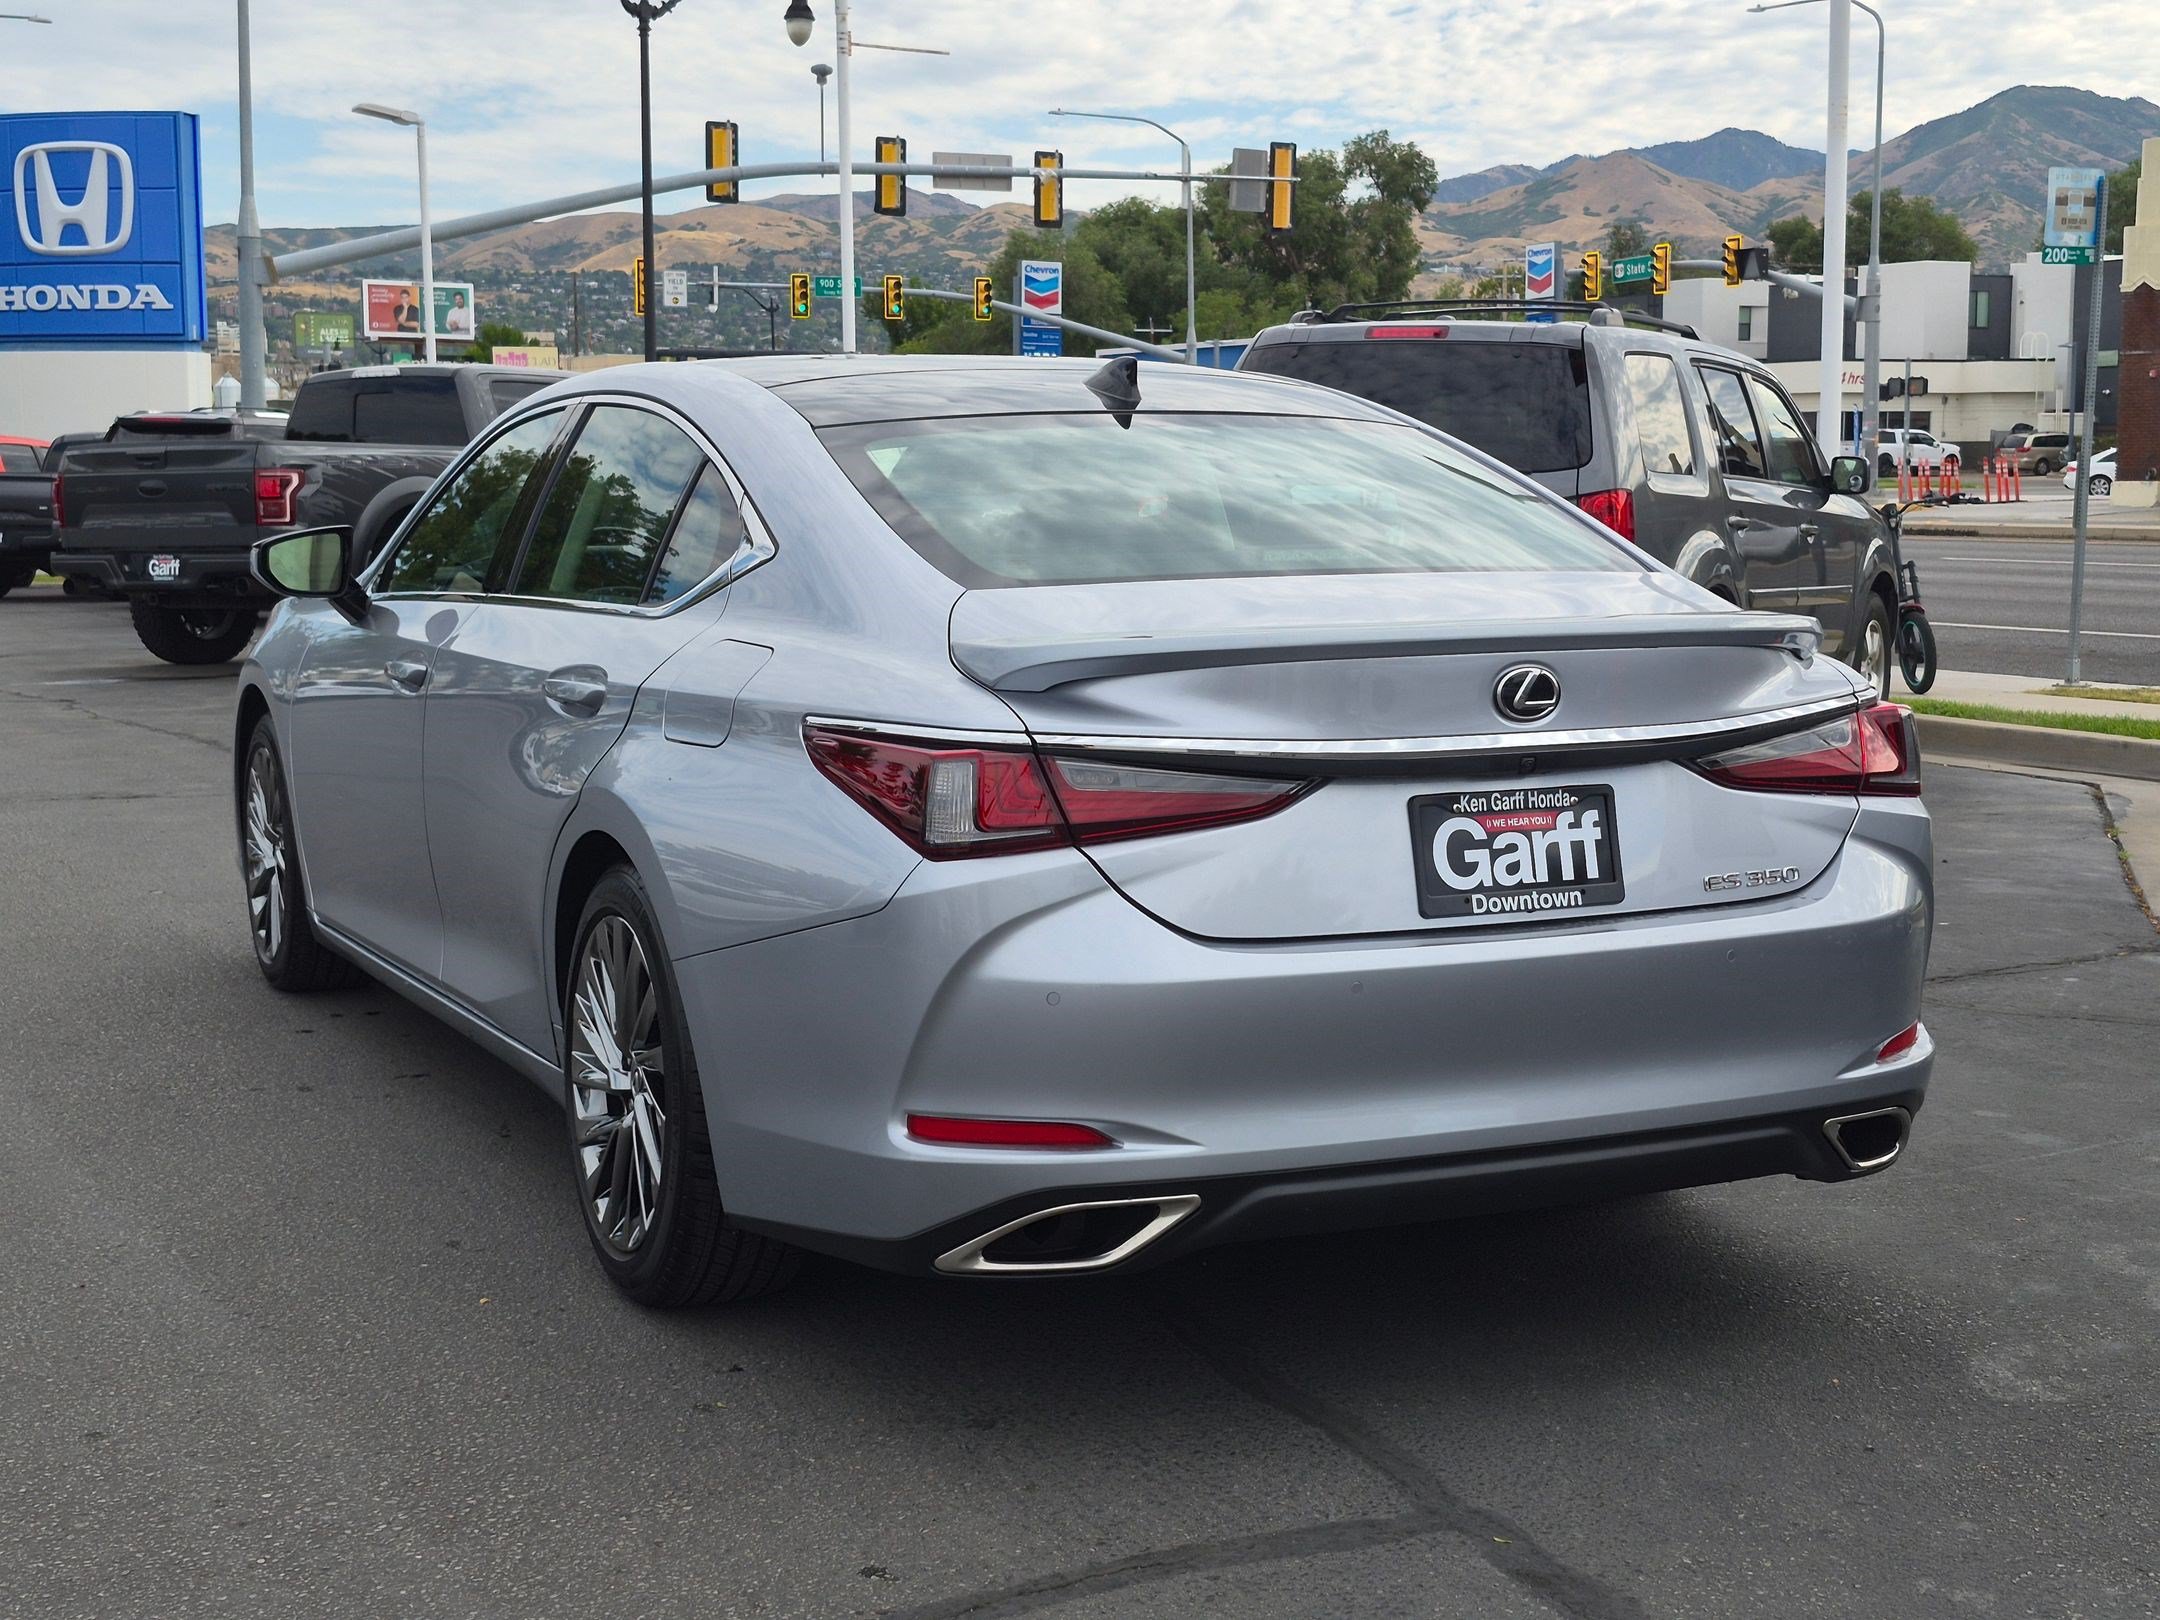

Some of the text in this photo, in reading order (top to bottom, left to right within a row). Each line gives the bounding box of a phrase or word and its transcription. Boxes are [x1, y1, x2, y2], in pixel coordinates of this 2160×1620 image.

[1528, 248, 1553, 258] Chevron
[2045, 247, 2068, 263] 200
[1024, 264, 1060, 275] Chevron
[1626, 263, 1646, 275] State
[819, 279, 835, 288] 900
[0, 284, 174, 311] HONDA
[149, 559, 180, 576] Garff
[1460, 788, 1570, 813] Ken Garff Honda
[1491, 816, 1547, 827] WE HEAR YOU
[1432, 809, 1602, 891] Garff
[1703, 865, 1800, 892] ES 350
[1471, 889, 1583, 914] Downtown
